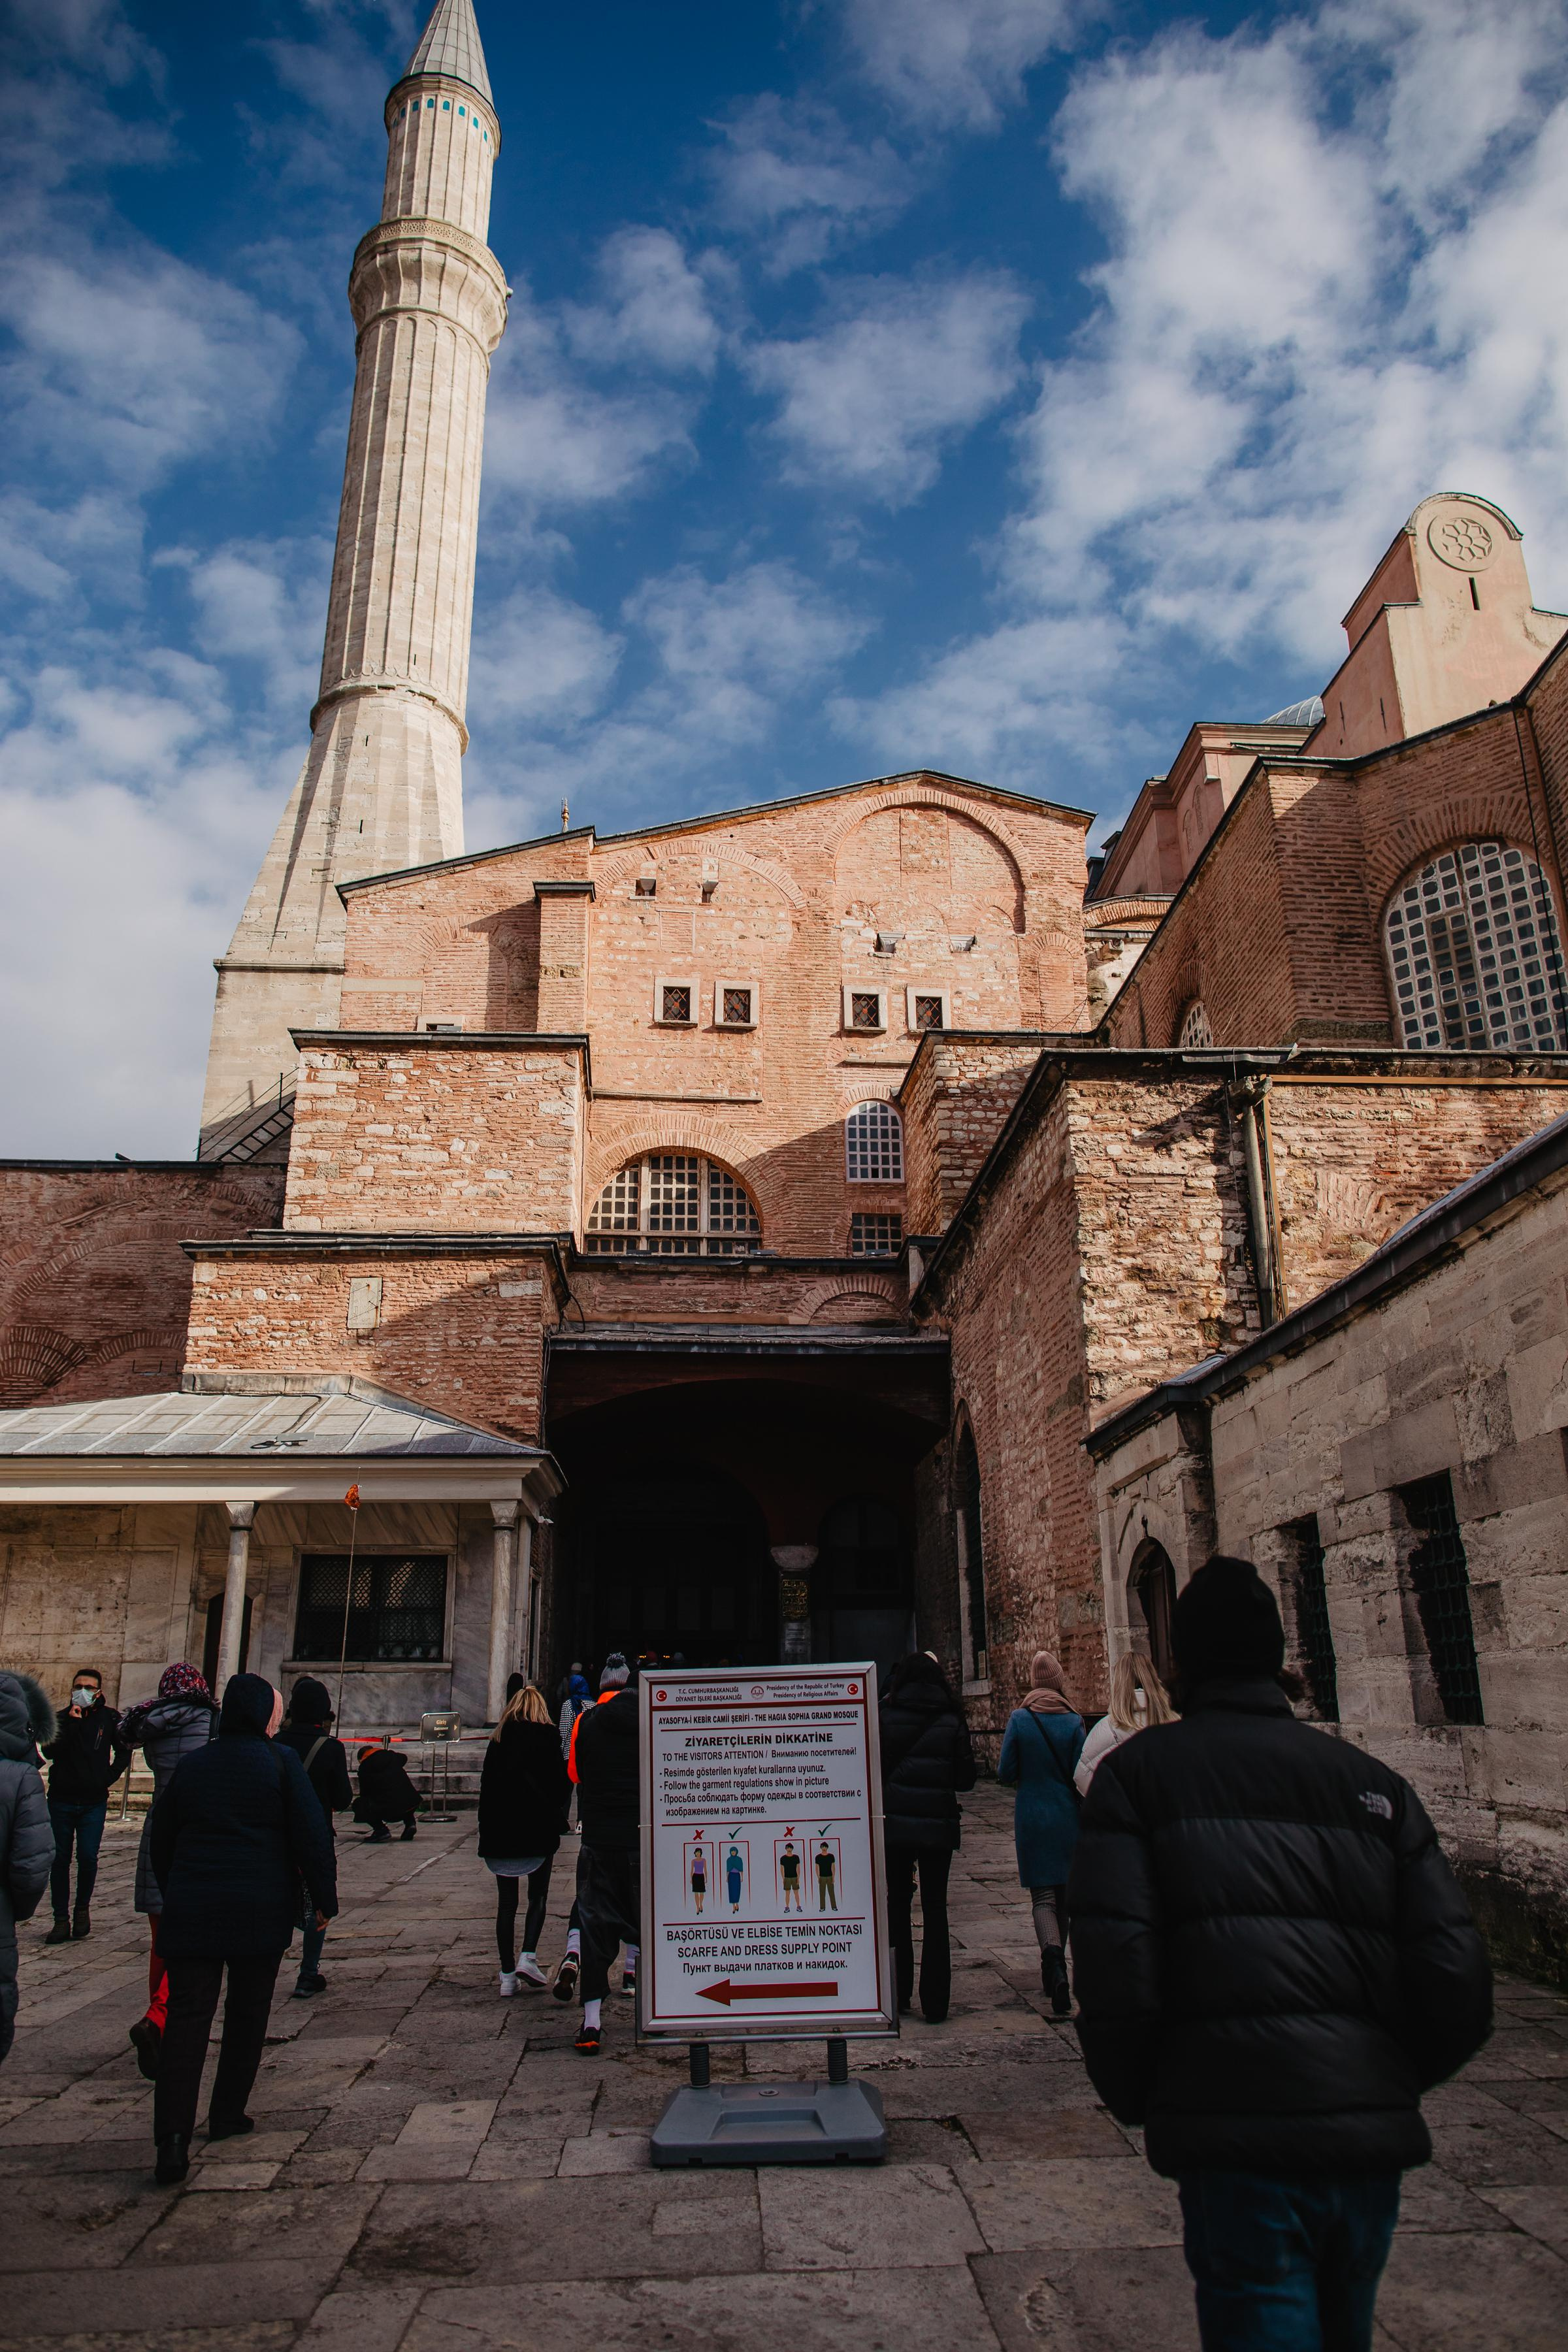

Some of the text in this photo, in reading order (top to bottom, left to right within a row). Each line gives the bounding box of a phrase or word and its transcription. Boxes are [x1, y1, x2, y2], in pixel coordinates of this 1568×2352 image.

[688, 1686, 739, 1695] CUMHURBAŞKANLIĞI
[697, 1694, 712, 1703] İŞLERİ
[713, 1693, 742, 1703] BAŞKANLIĞI
[693, 1714, 711, 1724] KEBİR
[712, 1713, 730, 1723] CAMİİ
[730, 1712, 750, 1725] ŞERİFİ
[768, 1713, 787, 1722] HAGIA
[788, 1712, 810, 1721] SOPHIA
[811, 1711, 832, 1720] GRAND
[833, 1710, 858, 1719] MOSQUE
[685, 1731, 833, 1748] ZİYARETÇİLERİN DİKKATİNE
[662, 1753, 672, 1761] TO
[674, 1752, 689, 1761] THE
[689, 1751, 723, 1761] VISITORS
[724, 1750, 764, 1760] ATTENTION
[771, 1746, 857, 1758] Вниманию посетителей!
[664, 1767, 694, 1778] Resimde
[696, 1766, 732, 1779] gösterilen
[733, 1765, 757, 1778] kıyafet
[759, 1764, 796, 1774] kurallarına
[798, 1765, 826, 1776] uyunuz.
[664, 1780, 687, 1790] Follow
[689, 1780, 700, 1790] the
[702, 1779, 732, 1791] garment
[733, 1778, 774, 1791] regulations
[775, 1777, 794, 1787] show
[796, 1776, 802, 1786] in
[804, 1776, 830, 1788] picture
[664, 1793, 696, 1806] Просьба
[697, 1792, 739, 1804] соблюдать
[740, 1790, 766, 1803] форму
[767, 1791, 796, 1802] одежды
[805, 1789, 855, 1799] соответствии
[666, 1806, 719, 1818] изображением
[732, 1806, 767, 1816] картинке.
[666, 1923, 862, 1943] BAŞÖRTÜSÜ VE ELBİSE TEMİN NOKTASI
[678, 1942, 852, 1958] SCARFE AND DRESS SUPPLY POINT
[683, 1963, 711, 1976] Пункт
[713, 1963, 751, 1974] выдачи
[754, 1961, 794, 1971] платков
[805, 1960, 848, 1970] накидок.
